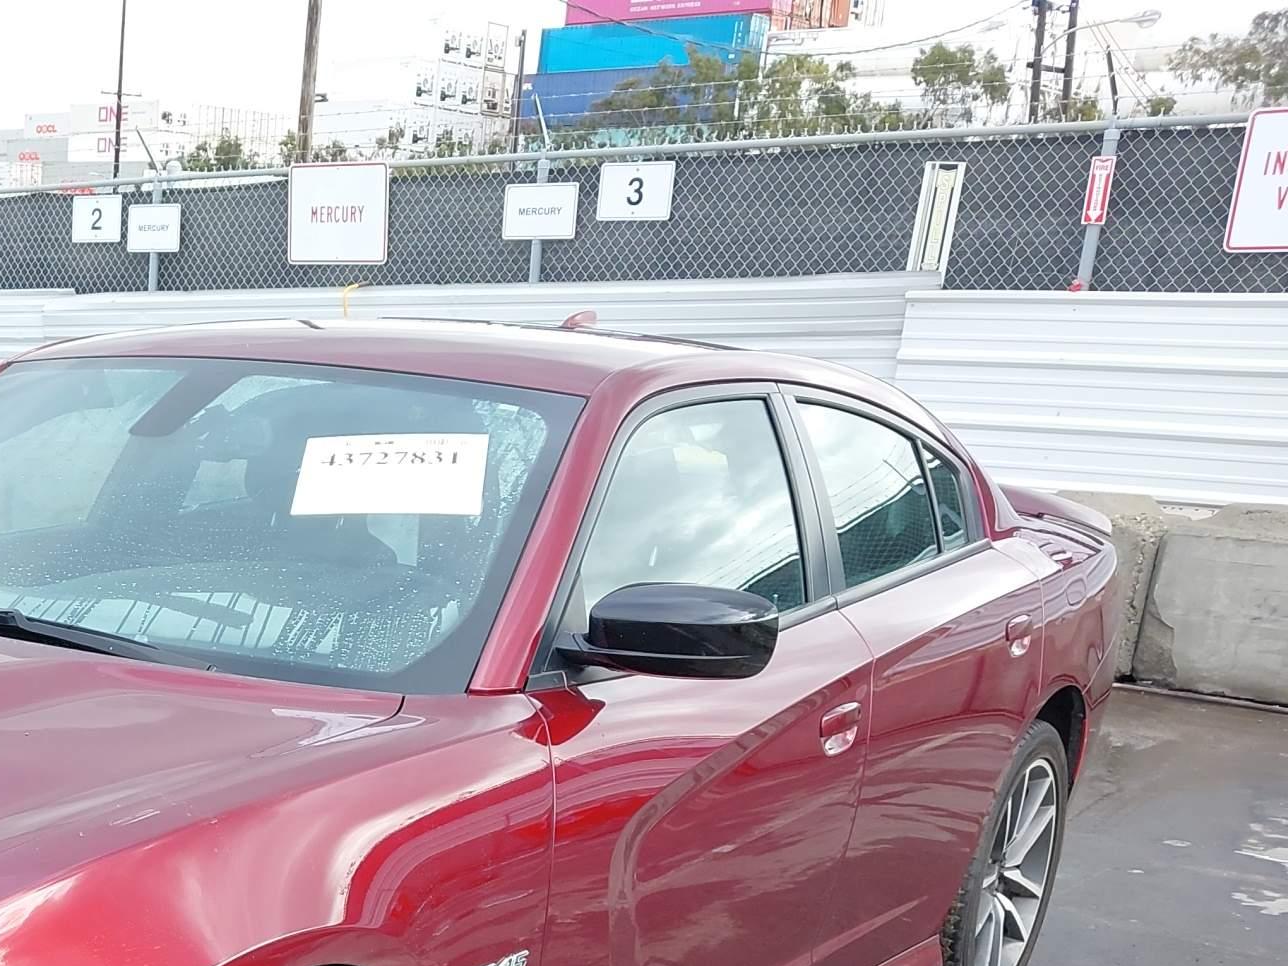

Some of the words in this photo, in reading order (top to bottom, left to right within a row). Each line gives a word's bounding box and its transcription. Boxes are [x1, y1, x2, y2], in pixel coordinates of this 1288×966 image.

[99, 105, 129, 122] ONE
[36, 124, 57, 134] OOCL
[97, 137, 127, 153] ONE
[626, 177, 644, 206] 3
[91, 208, 102, 230] 2
[311, 206, 365, 224] MERCURY
[518, 207, 562, 216] MERCURY
[320, 451, 458, 466] 43727831
